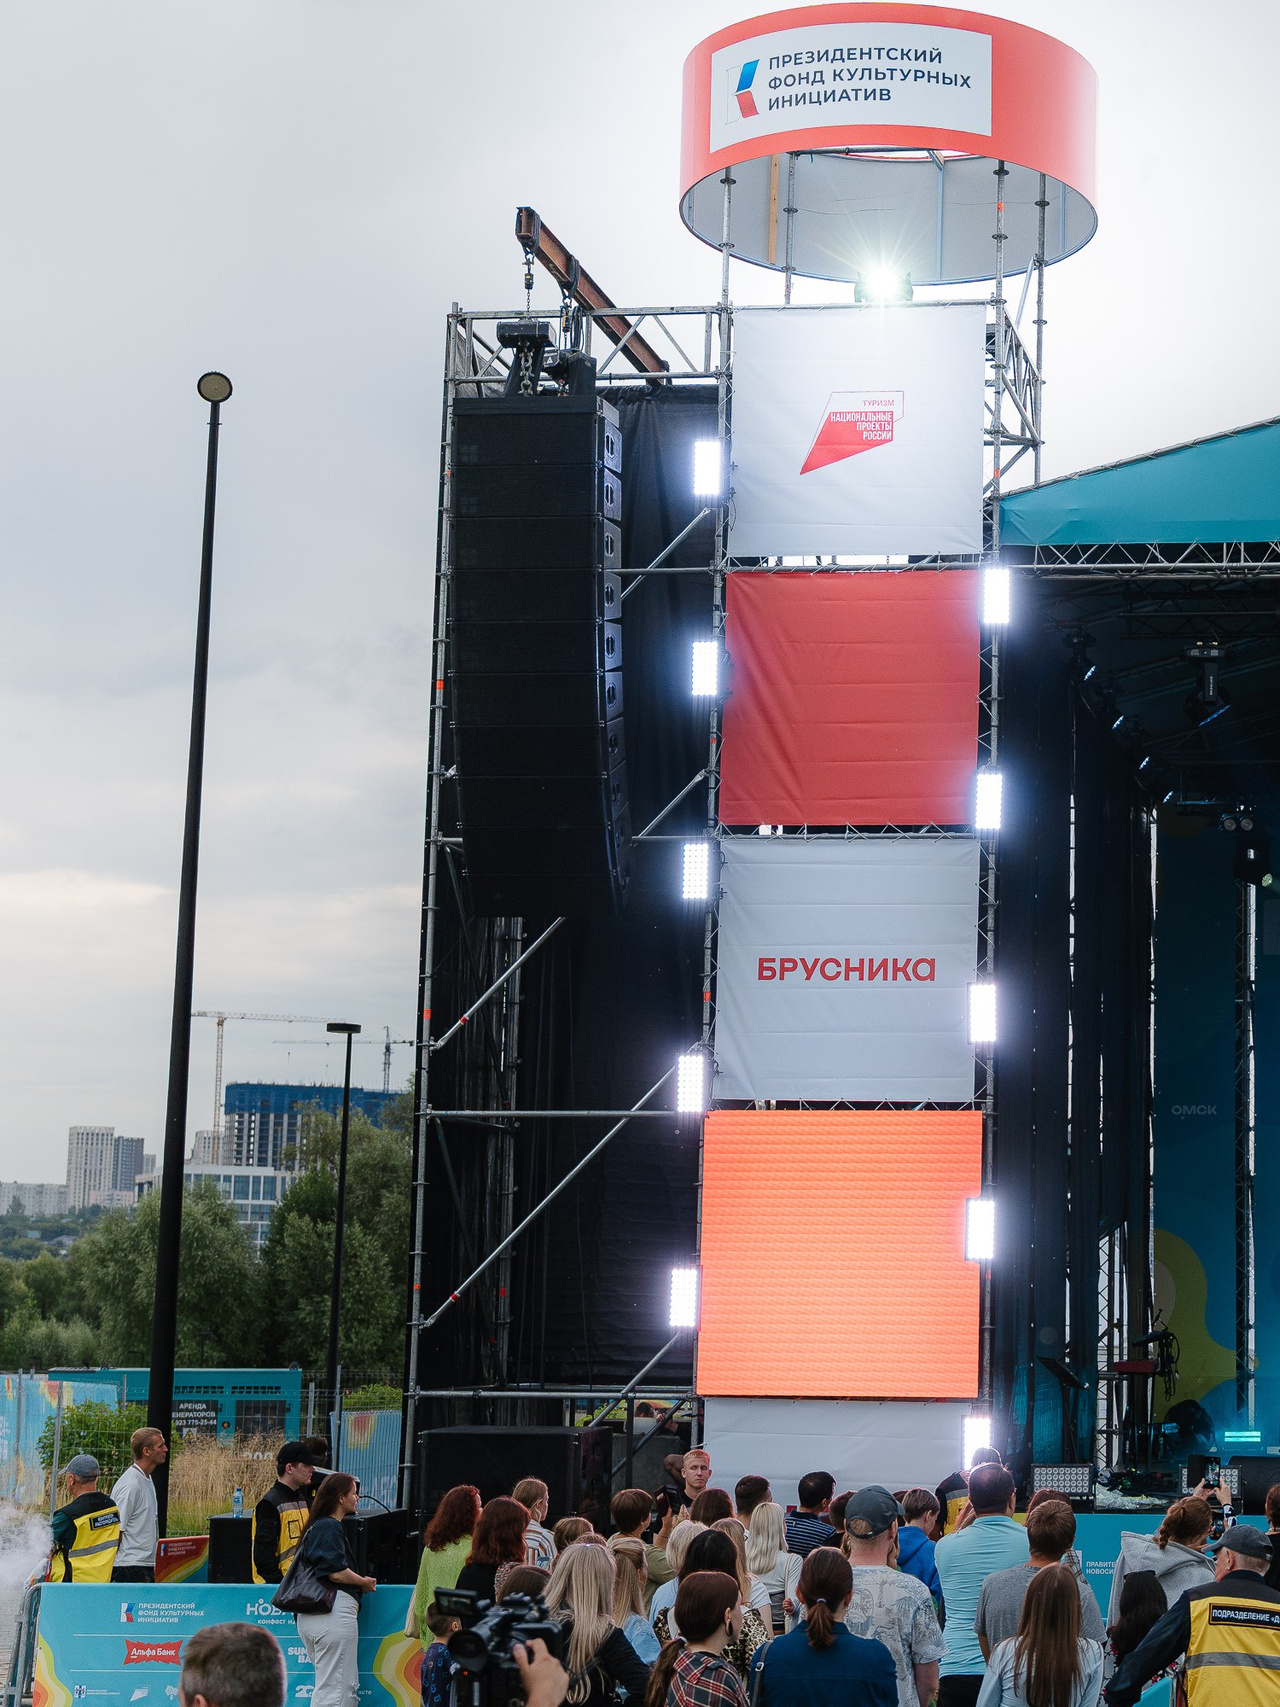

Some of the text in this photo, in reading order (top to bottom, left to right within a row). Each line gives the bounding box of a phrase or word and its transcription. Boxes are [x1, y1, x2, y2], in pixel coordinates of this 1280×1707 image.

[769, 47, 942, 70] ПРЕЗИДЕНТСКИЙ
[768, 68, 971, 90] ФОНД КУЛЬТУРНЫХ
[768, 88, 892, 111] ИНИЦИАТИВ
[862, 399, 895, 407] ТУРИЗМ
[830, 412, 892, 422] НАЦИОНАЛЬНЫЕ
[856, 422, 892, 431] ПРОЕКТЫ
[862, 431, 892, 440] РОССИИ
[1171, 1104, 1217, 1115] ОМСК
[138, 1609, 205, 1617] ФОНД КУЛЬТУРНЫХ
[1212, 1609, 1270, 1621] ПОДРАЗДЕЛЕНИЕ
[138, 1616, 179, 1624] ИНИЦИАТИВ
[131, 1647, 176, 1657] Альфа Банк
